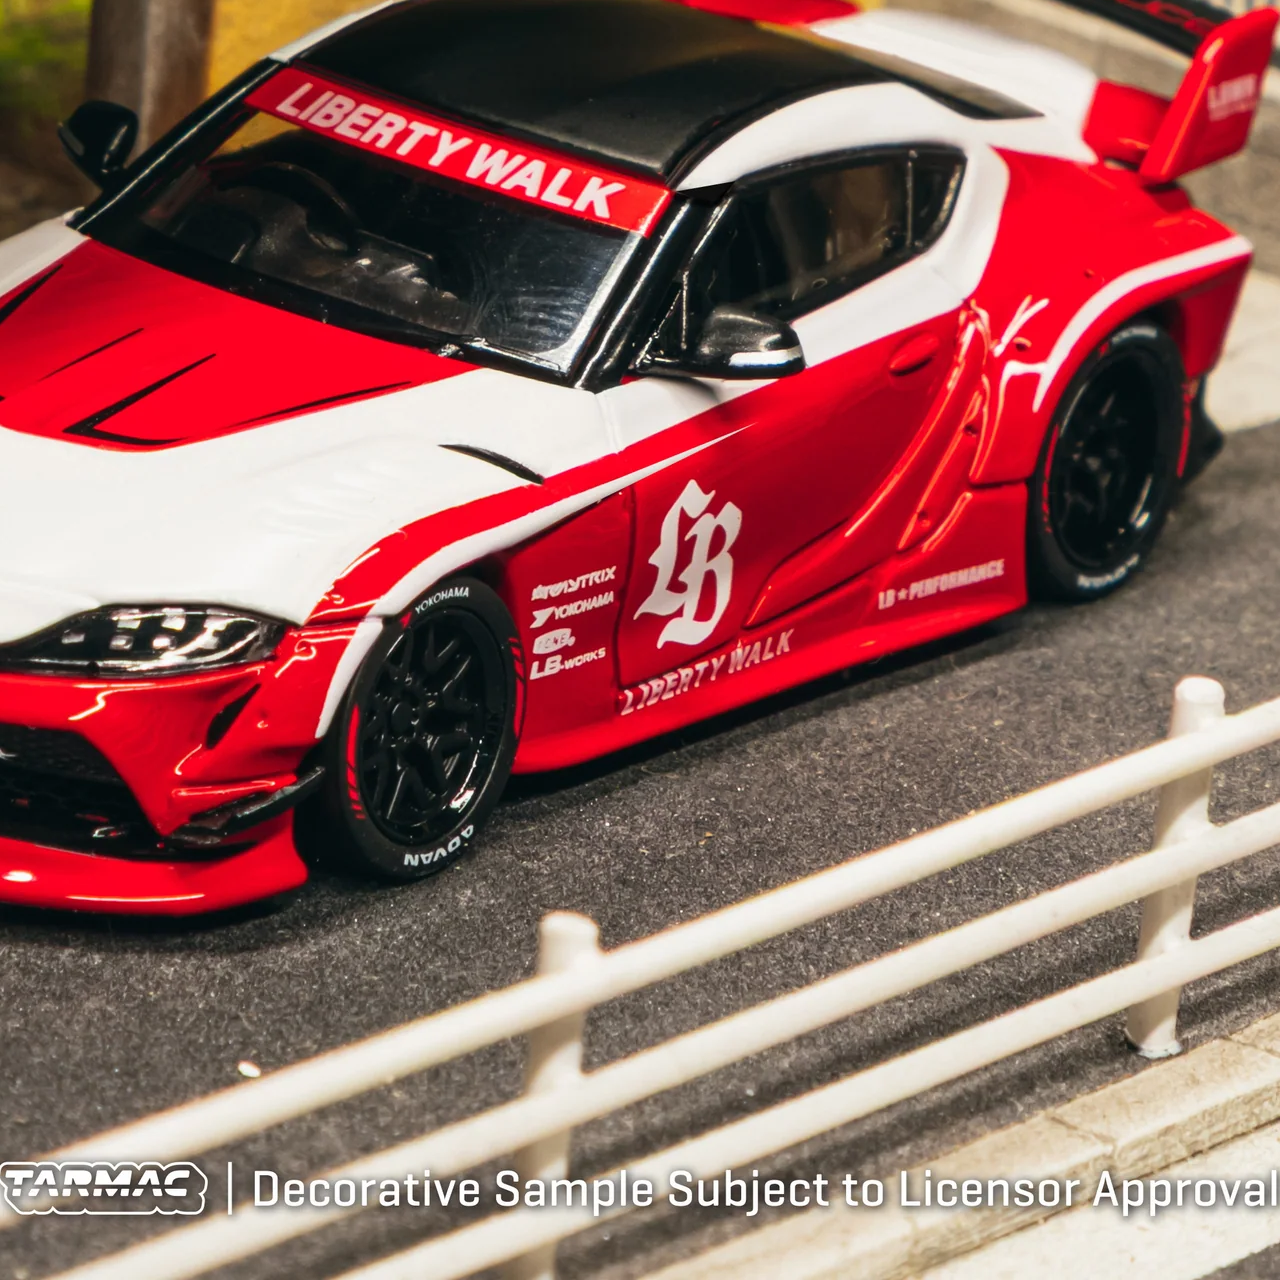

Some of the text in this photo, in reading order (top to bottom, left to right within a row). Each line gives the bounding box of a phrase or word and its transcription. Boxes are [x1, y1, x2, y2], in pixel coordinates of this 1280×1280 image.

[276, 83, 625, 219] LIBERTY WALK
[415, 586, 470, 615] YOKOHAMA
[553, 590, 615, 620] YOKOHAMA
[620, 628, 795, 716] LIBERTY WALK
[403, 824, 474, 867] ADVAN
